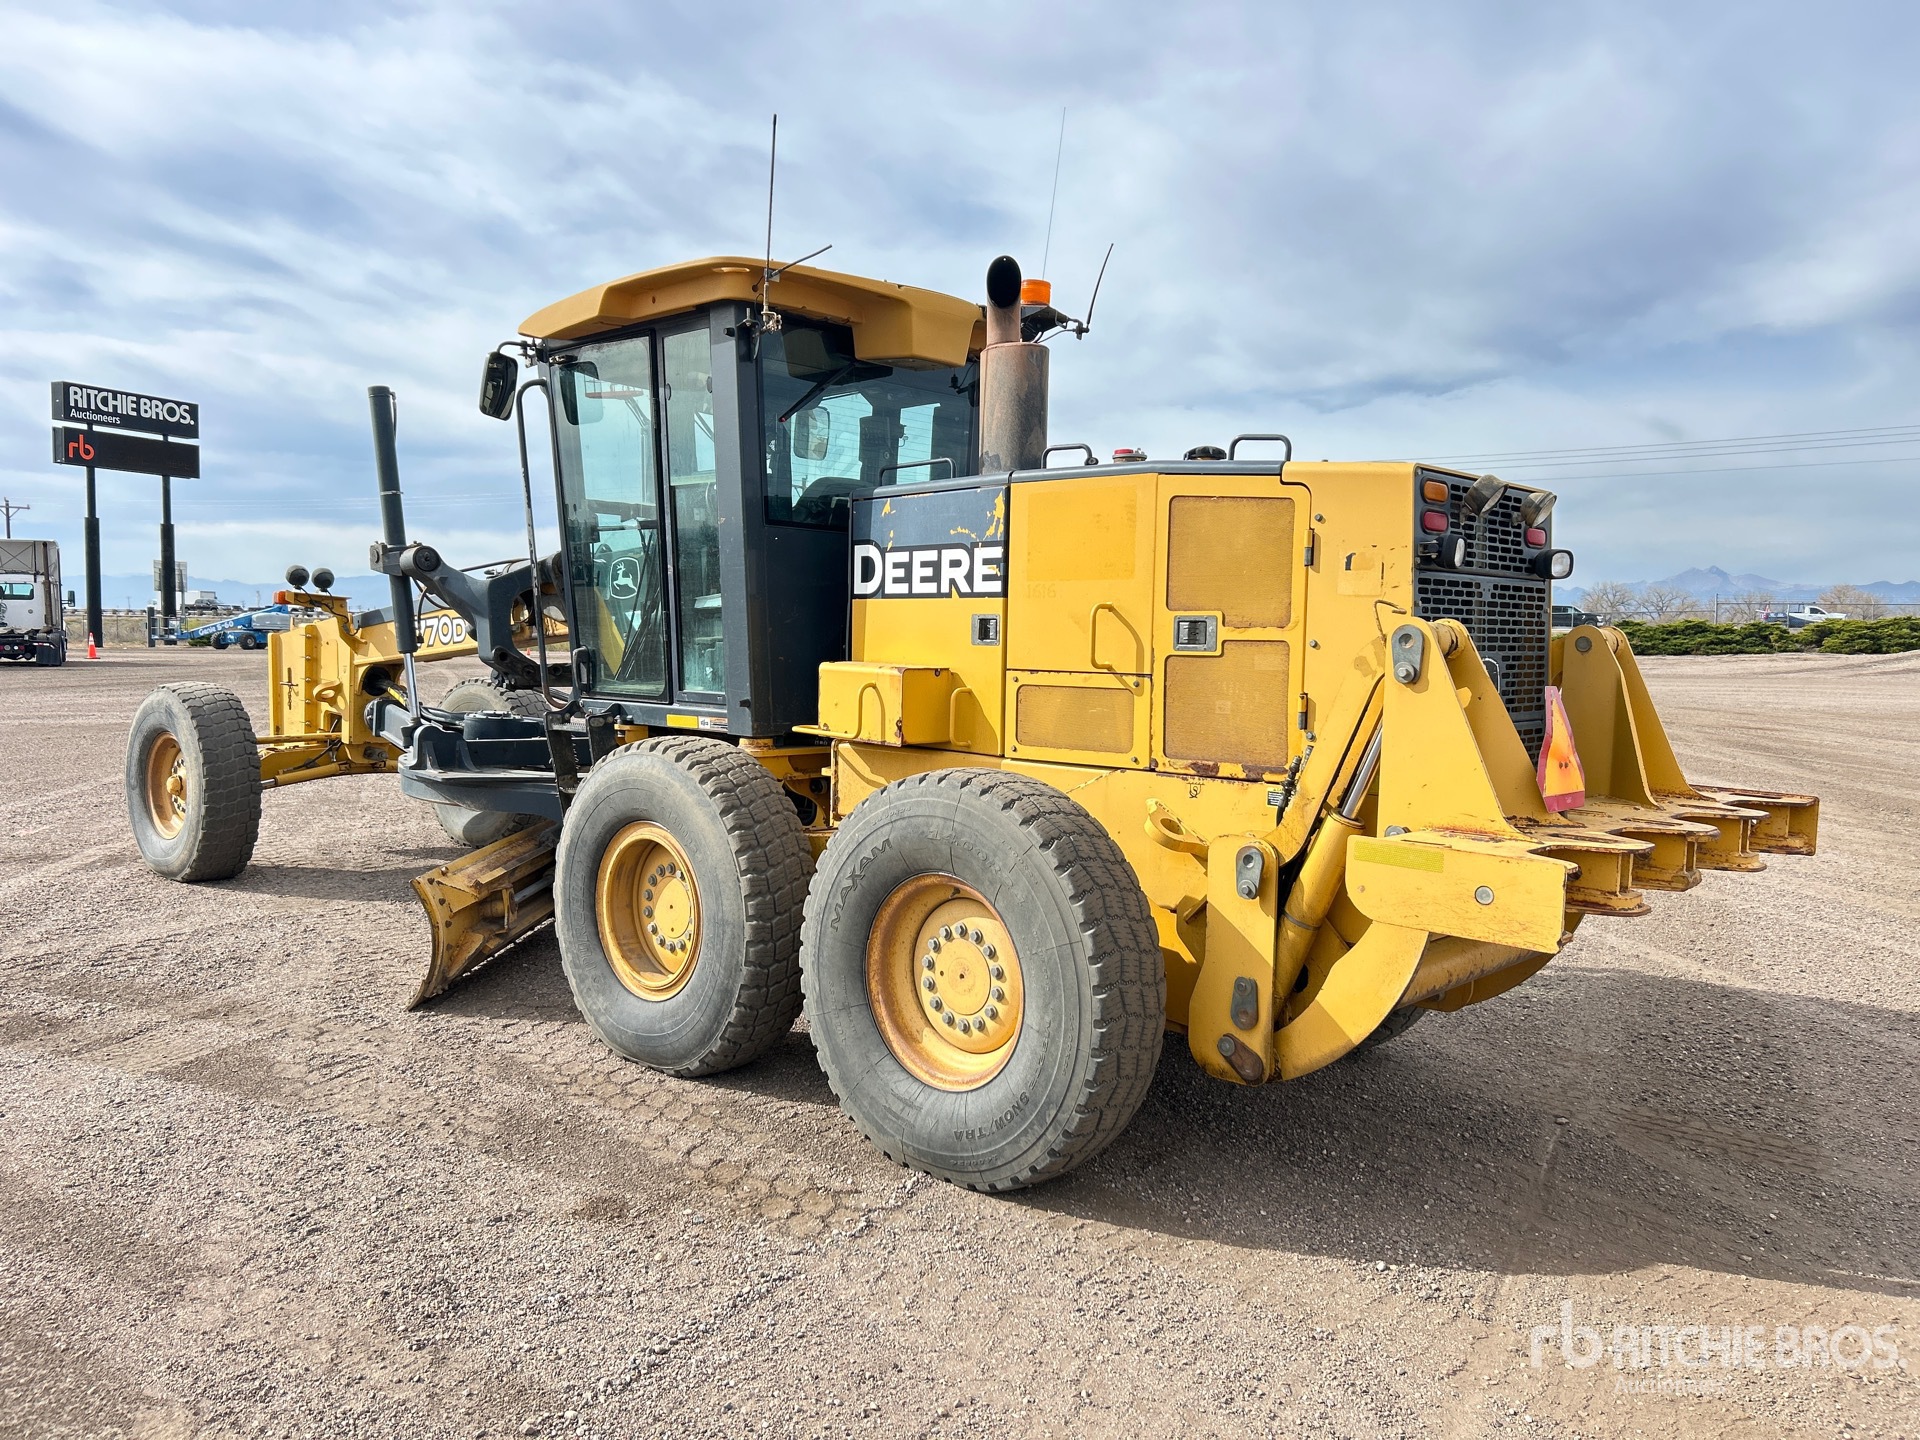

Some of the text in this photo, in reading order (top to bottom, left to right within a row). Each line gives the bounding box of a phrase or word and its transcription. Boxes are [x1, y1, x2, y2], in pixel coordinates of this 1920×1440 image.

[69, 386, 195, 425] RITCHIE BROS.
[70, 408, 121, 424] Auctioneers
[68, 434, 95, 460] rb
[853, 544, 1003, 594] DEERE
[830, 838, 893, 932] MAXAM
